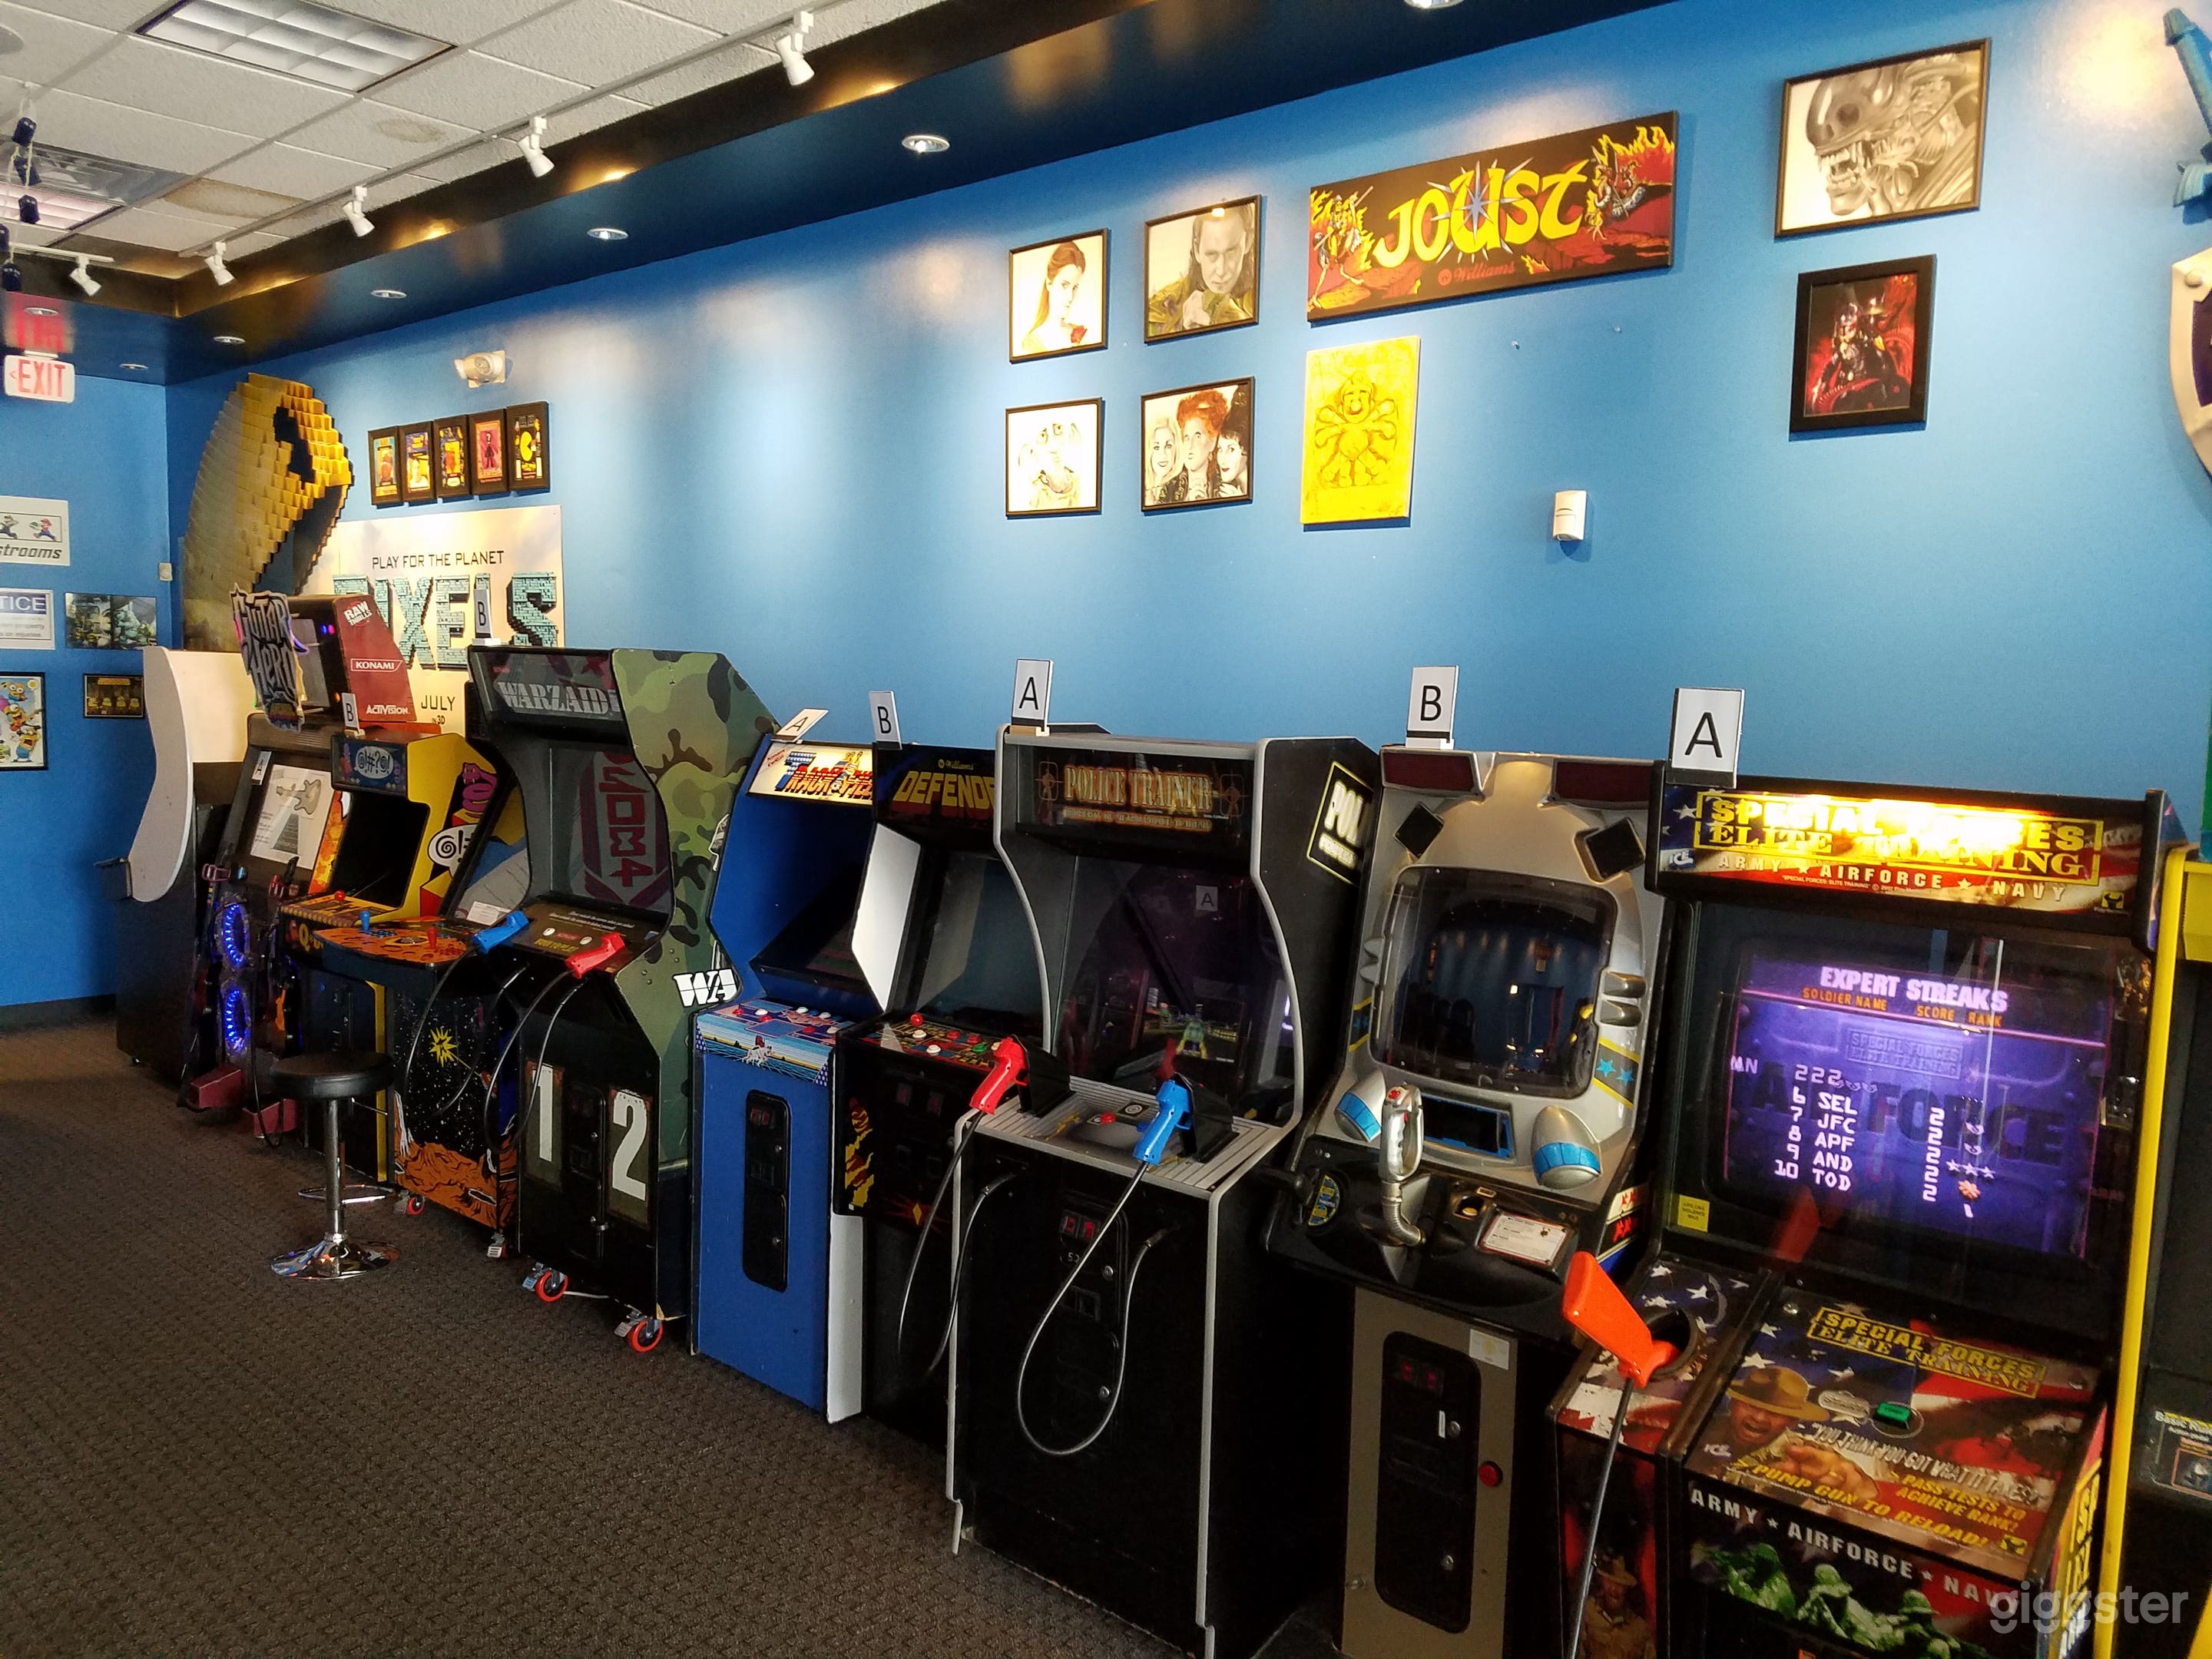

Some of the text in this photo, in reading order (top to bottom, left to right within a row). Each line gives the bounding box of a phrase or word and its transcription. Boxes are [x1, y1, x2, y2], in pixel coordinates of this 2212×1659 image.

[18, 359, 66, 398] EXIT
[372, 550, 505, 569] PLAY FOR THE PLANET
[478, 601, 486, 626] B
[356, 661, 395, 670] KONAMI
[346, 703, 354, 722] B
[421, 695, 455, 712] JULY
[497, 680, 609, 715] WARZAID
[1019, 677, 1038, 710] A
[1420, 685, 1442, 720] B
[437, 715, 445, 725] 3D
[786, 717, 808, 731] A
[877, 706, 892, 733] B
[1684, 712, 1723, 758] A
[1065, 767, 1213, 811] POLICE TRAINER
[1709, 824, 1833, 854] ELITE
[1718, 856, 2066, 902] ARMY AIRFORCE NAVY
[1803, 987, 2004, 1028] SOLDIER NAME SCORE RANK
[1820, 965, 2009, 1013] EXPERT STREAKS
[1794, 1064, 1843, 1087] 222
[531, 1065, 554, 1162] 1
[1793, 1085, 1945, 1126] 6 SEL 2
[1788, 1125, 1941, 1164] 8 APF 2
[1790, 1106, 1943, 1145] 7 JFC 2
[612, 1091, 647, 1201] 2
[1786, 1143, 1939, 1183] 9 AND 2
[1774, 1159, 1938, 1201] 10 TOD 2
[1819, 1325, 2031, 1392] ELITE TRAINING
[1823, 1313, 2036, 1381] SPECIAL FORCES
[1904, 1451, 1933, 1472] GOT
[1929, 1461, 1970, 1483] WHAT
[1751, 1463, 1813, 1488] PUMP
[1813, 1484, 1859, 1506] GUN
[1863, 1499, 1891, 1516] TO
[1892, 1510, 1989, 1548] RELOAD!
[1895, 1486, 1968, 1517] ACHIEVE
[1901, 1475, 2028, 1522] PASS TESTS TO
[1690, 1488, 1759, 1525] ARMY
[1786, 1522, 1914, 1580] AIRFORCE
